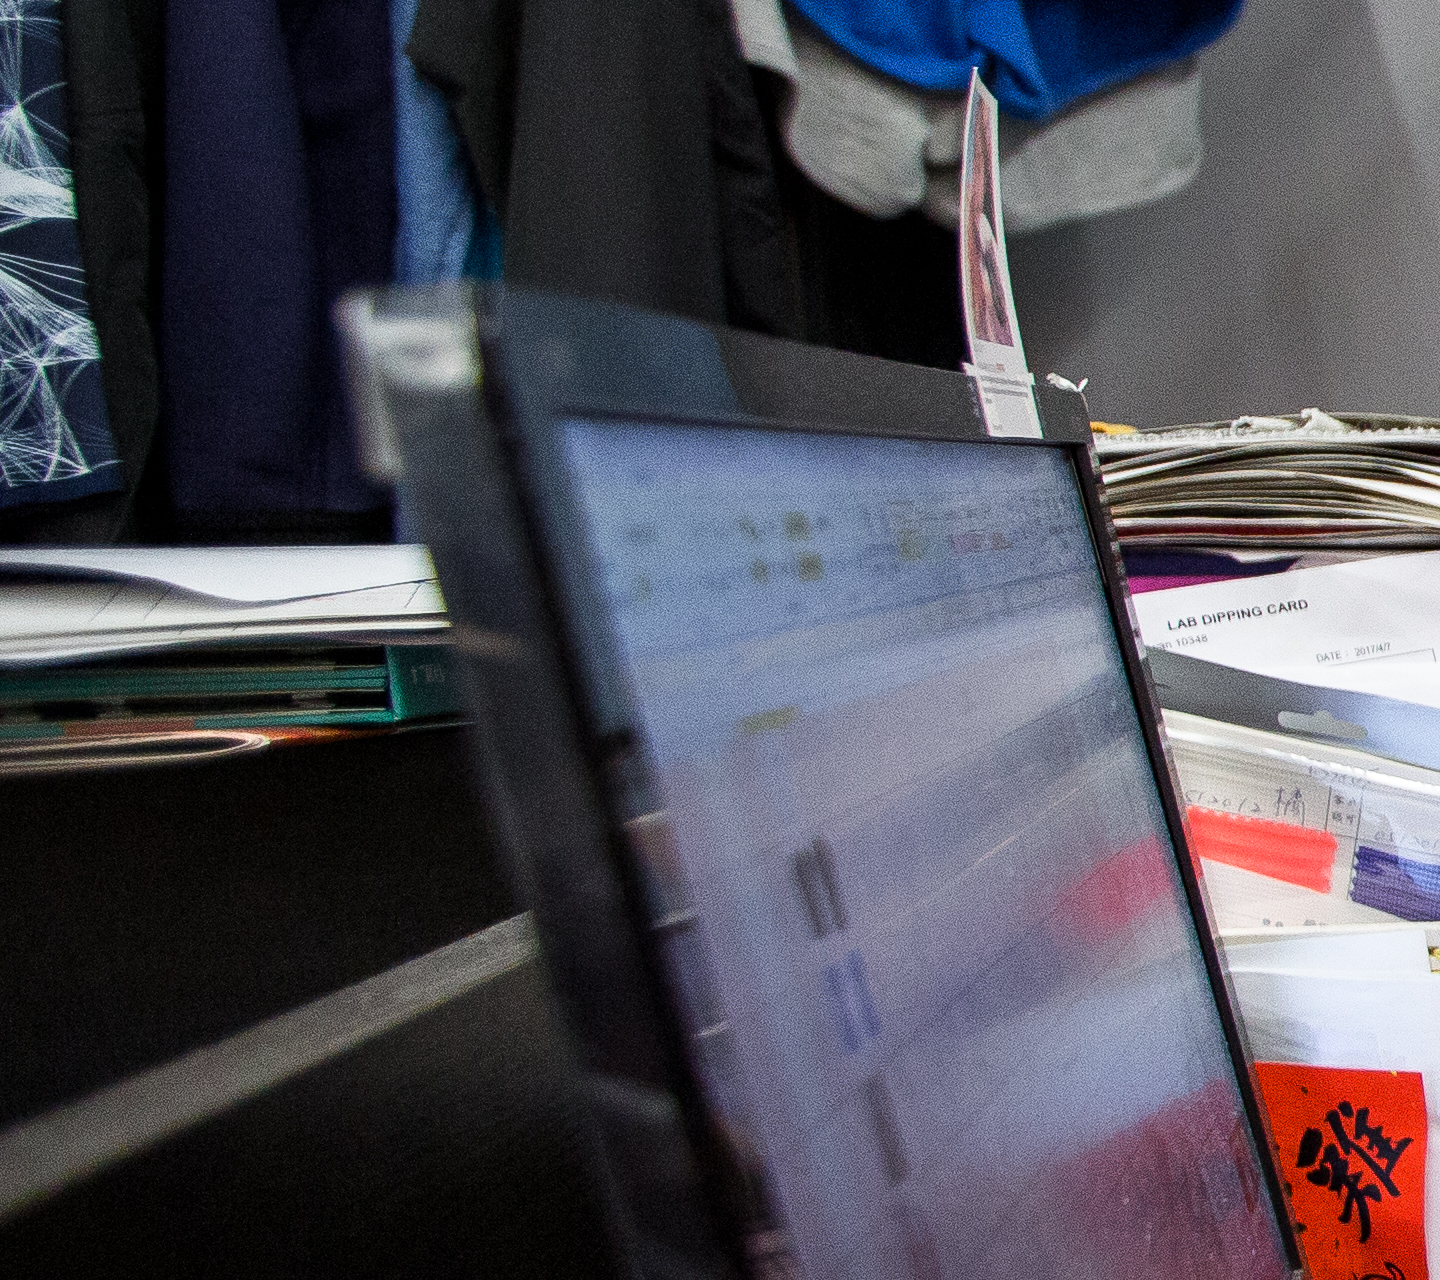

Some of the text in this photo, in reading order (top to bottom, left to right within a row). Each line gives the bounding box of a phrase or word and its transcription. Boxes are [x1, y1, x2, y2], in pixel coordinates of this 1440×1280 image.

[1167, 599, 1309, 631] LAB DIPPING CARD
